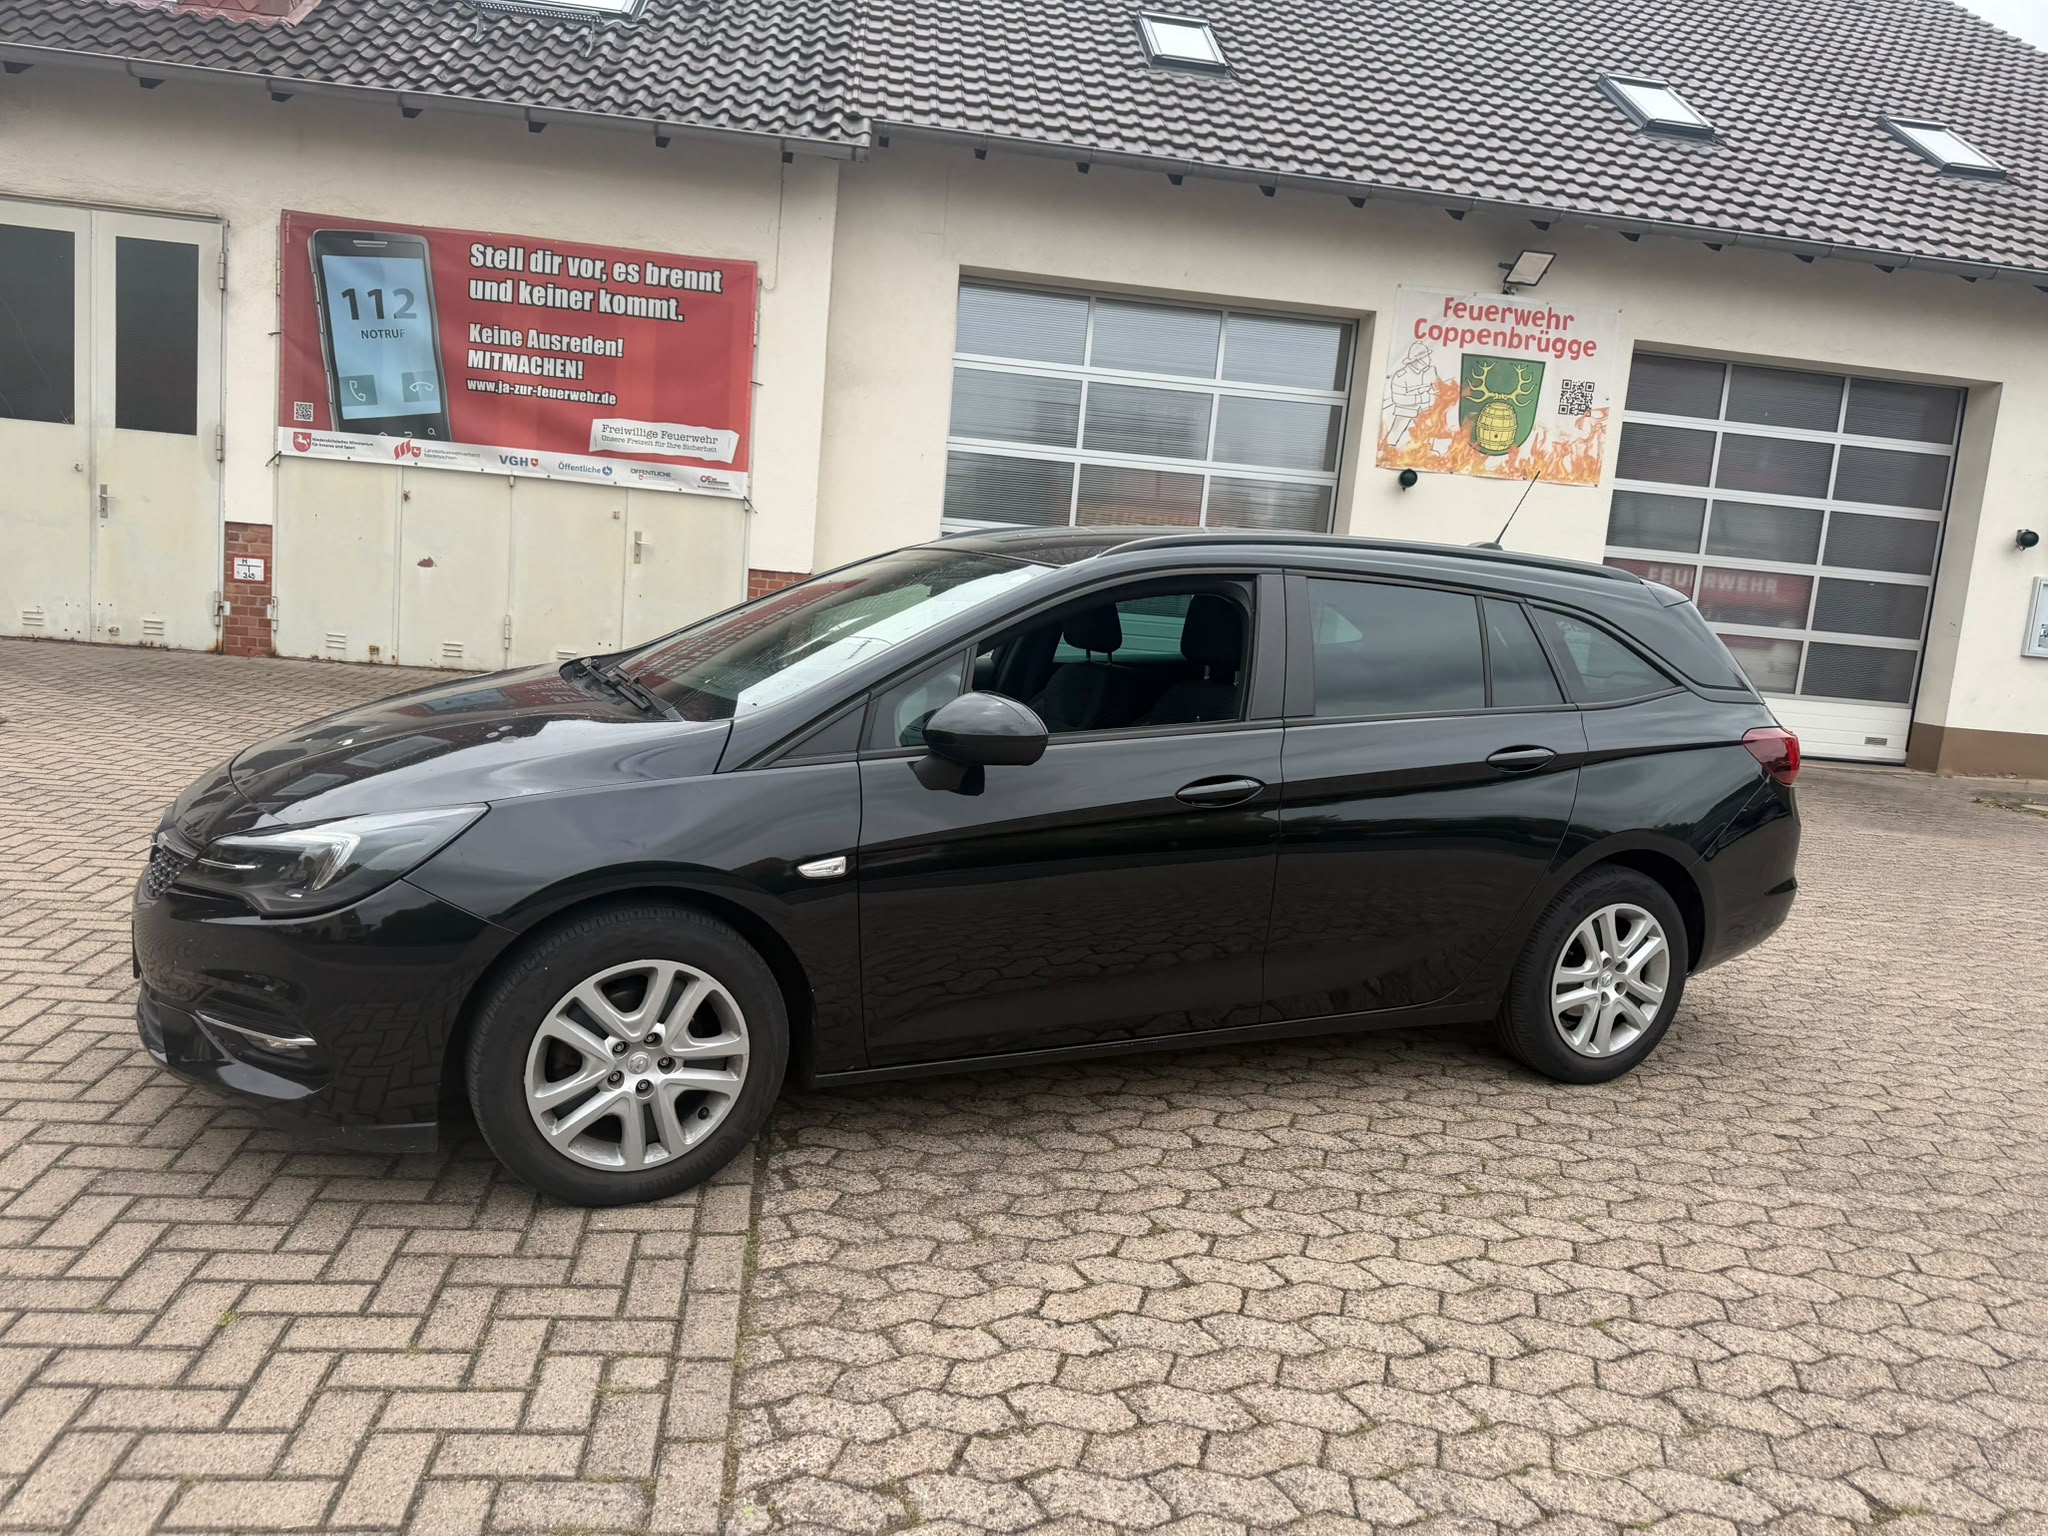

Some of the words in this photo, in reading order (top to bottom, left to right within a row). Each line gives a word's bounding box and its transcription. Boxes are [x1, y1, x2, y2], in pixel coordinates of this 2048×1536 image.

[469, 242, 525, 272] Stell
[528, 248, 563, 276] dir
[566, 255, 608, 284] vor,
[611, 260, 642, 285] es
[644, 260, 723, 294] brennt
[468, 278, 514, 304] und
[518, 279, 595, 312] keiner
[598, 288, 685, 323] kommt.
[1443, 297, 1575, 331] Feuerwehr
[360, 328, 405, 339] NOTRUF
[468, 322, 524, 348] Keine
[526, 328, 625, 358] Ausreden!
[1414, 318, 1597, 360] Coppenbrügge
[467, 349, 585, 381] MITMACHEN!
[466, 378, 618, 407] www.ja-zur-feuerwehr.de
[601, 423, 659, 439] Freiwillige
[660, 430, 719, 446] Feuerwehr
[601, 434, 626, 443] Unsere
[626, 437, 654, 447] Freizeit
[682, 443, 718, 453] Sicherheit
[499, 454, 529, 467] VGH
[558, 461, 601, 474] Öffentliche
